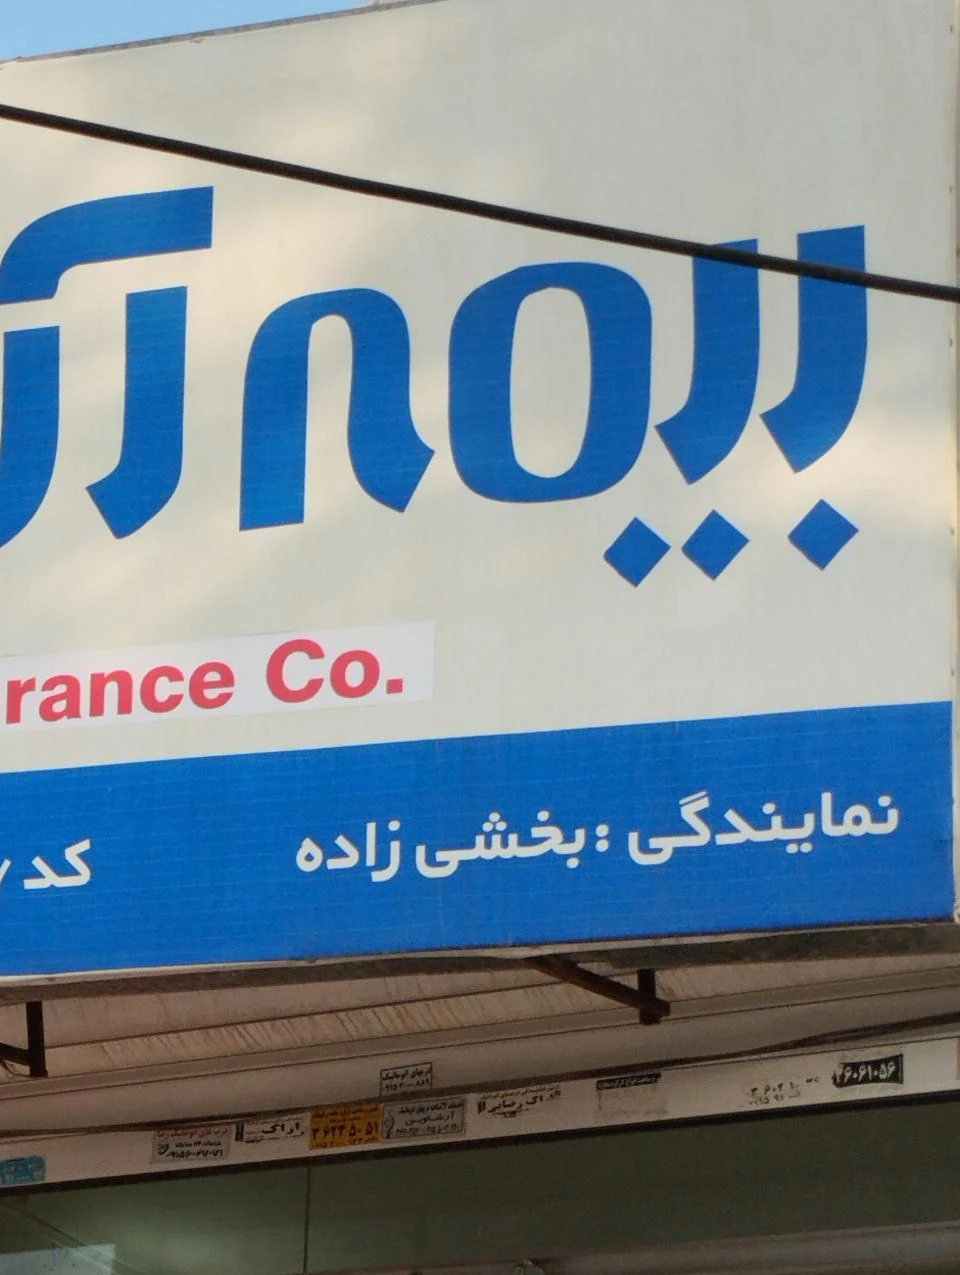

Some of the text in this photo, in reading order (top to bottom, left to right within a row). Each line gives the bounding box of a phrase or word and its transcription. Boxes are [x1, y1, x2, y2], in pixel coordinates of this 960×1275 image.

[240, 224, 869, 585] بیمه
[266, 638, 406, 704] Co.
[296, 819, 401, 882] زاده
[628, 790, 900, 866] نمایندگی
[22, 838, 92, 889] کد
